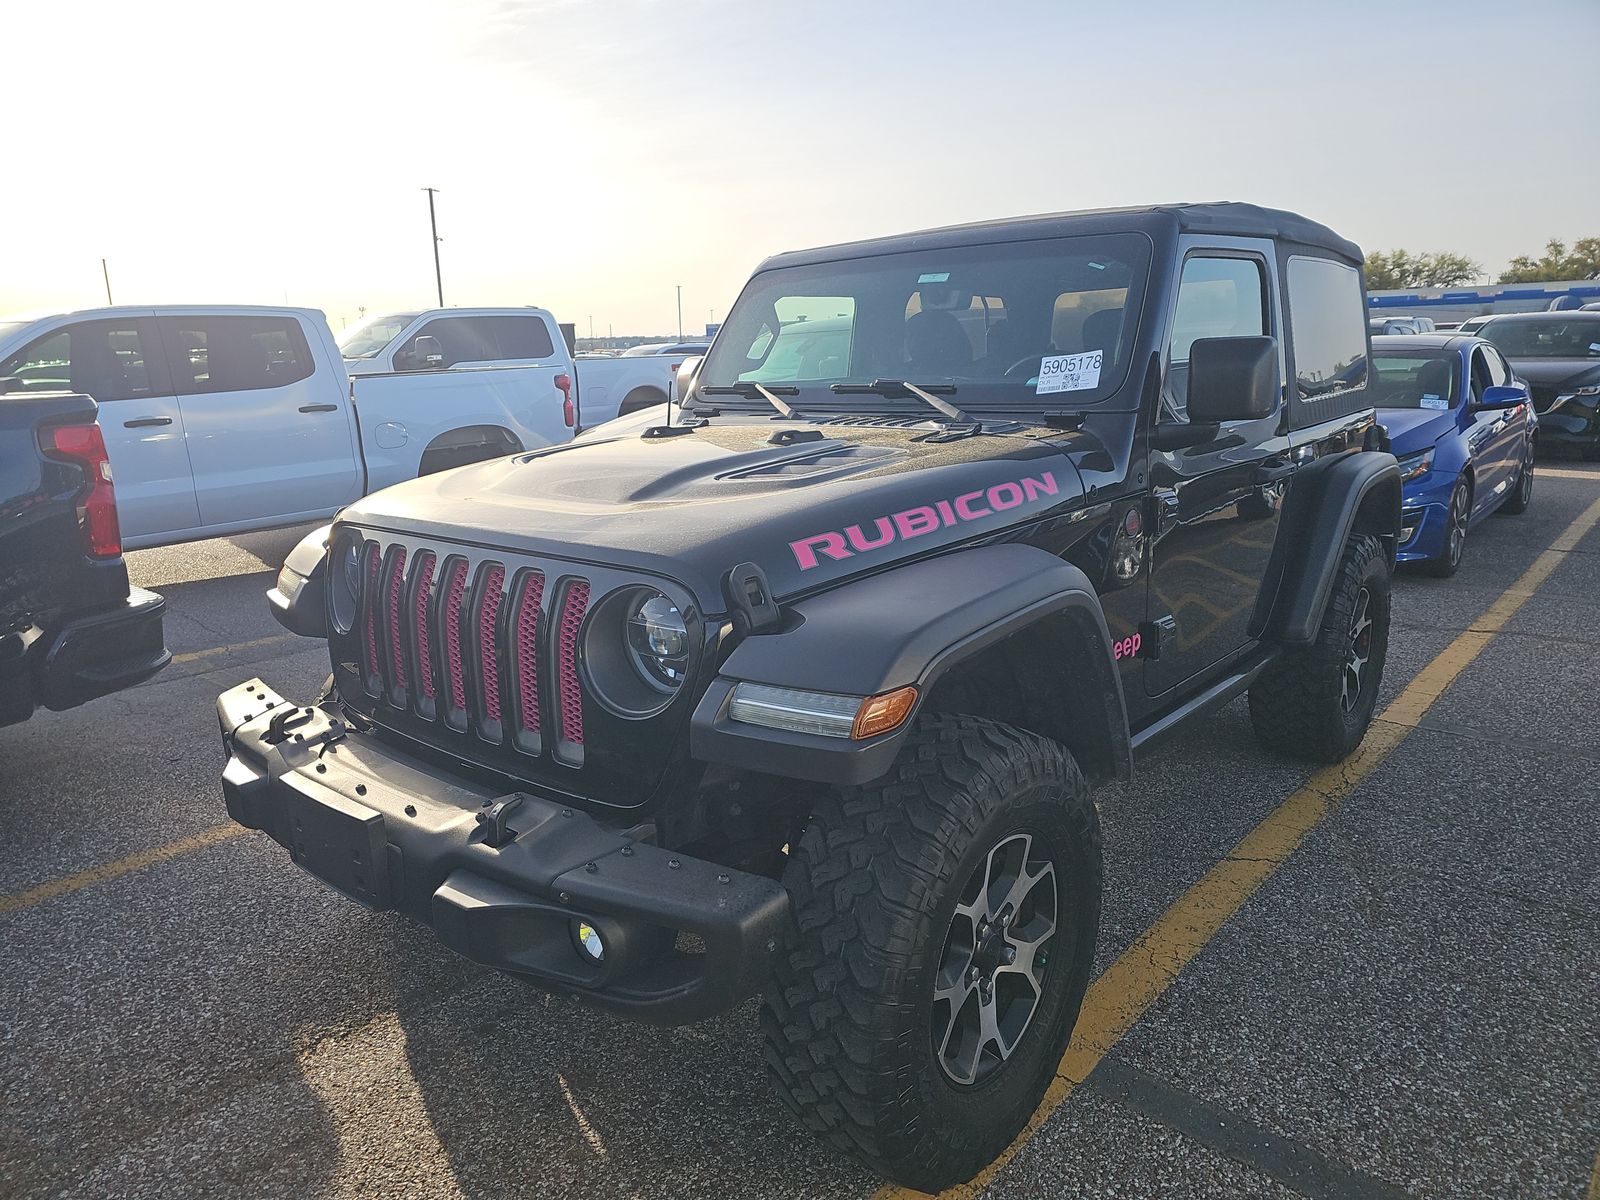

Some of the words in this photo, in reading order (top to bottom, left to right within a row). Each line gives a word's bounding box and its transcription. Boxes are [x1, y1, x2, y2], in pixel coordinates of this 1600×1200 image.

[1043, 354, 1102, 375] 5905178
[788, 471, 1059, 571] RUBICON
[1112, 633, 1141, 660] eep
